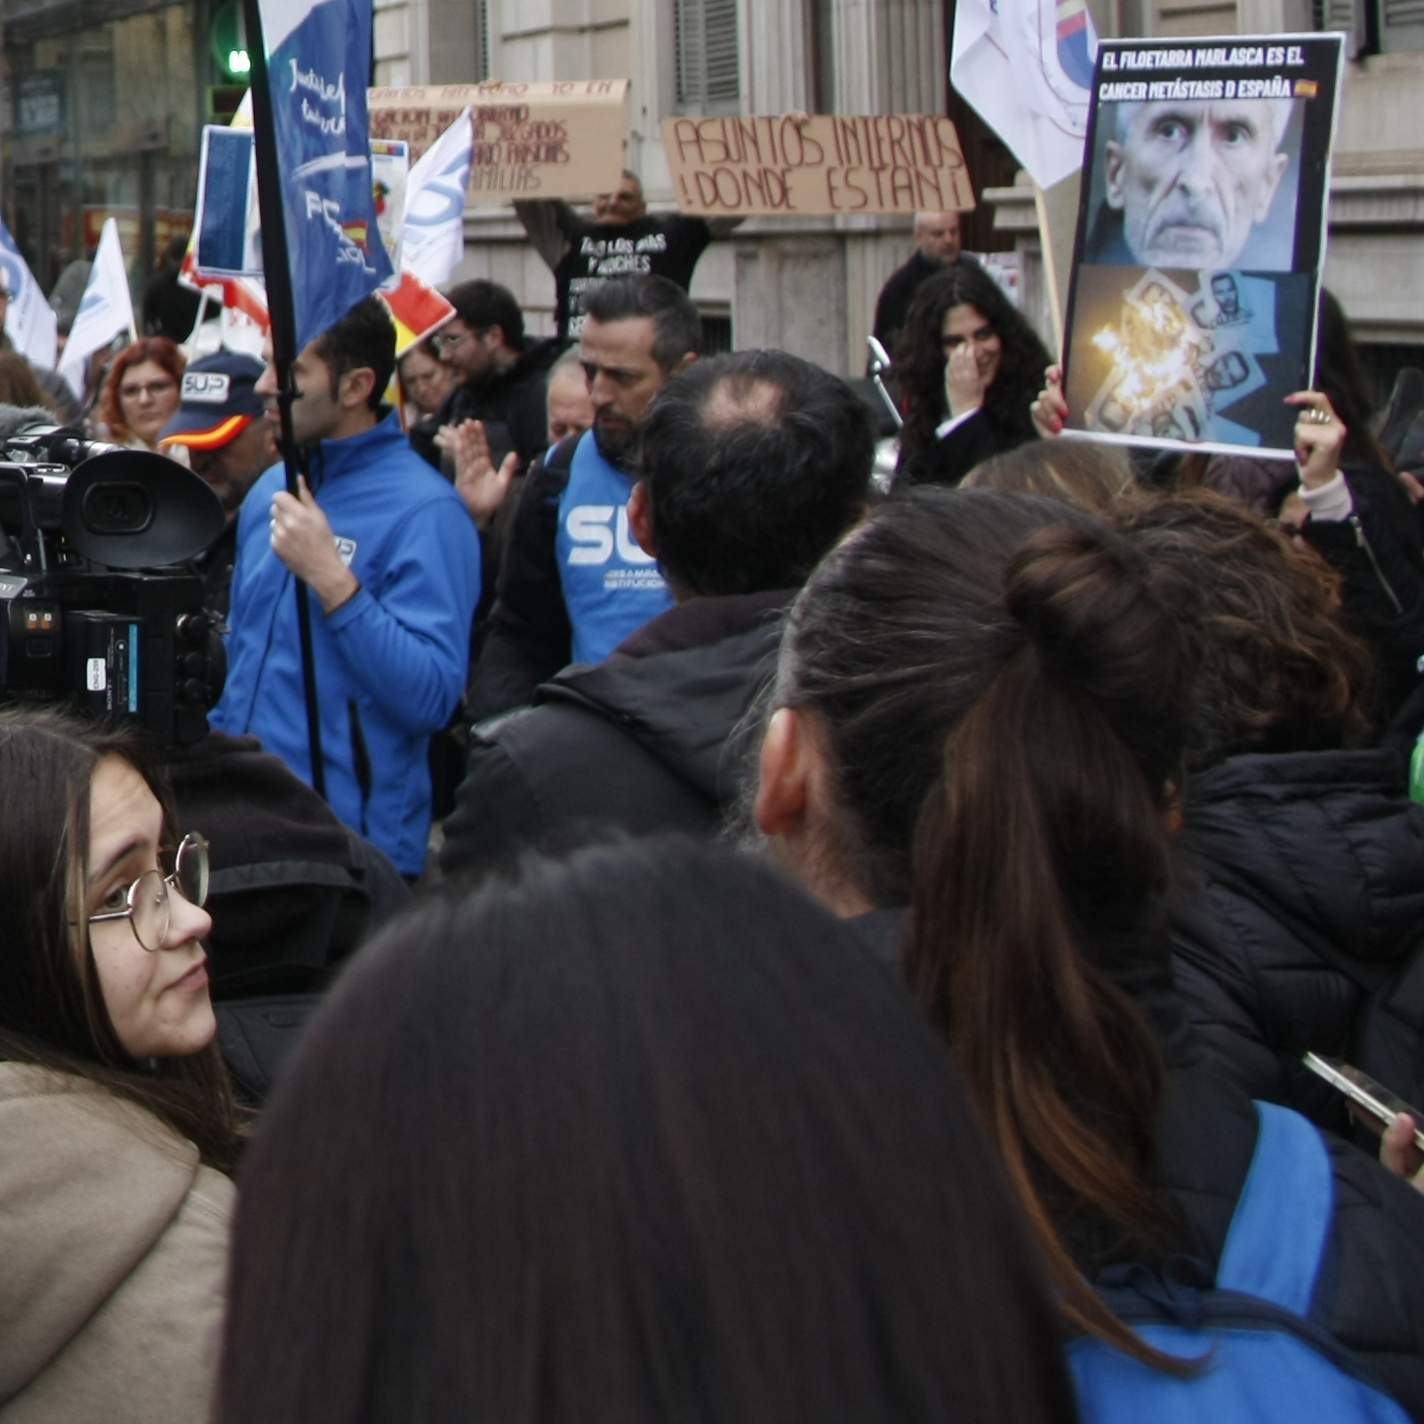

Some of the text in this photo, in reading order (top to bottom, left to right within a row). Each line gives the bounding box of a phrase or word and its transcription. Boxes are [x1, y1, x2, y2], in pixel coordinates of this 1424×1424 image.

[1103, 51, 1118, 70] EL
[1195, 48, 1265, 68] MARLASCA
[1267, 47, 1285, 66] ES
[1287, 46, 1304, 65] EL
[1099, 76, 1291, 102] CANCER METÁSTASIS D ESPAÑA
[674, 118, 825, 168] ASUNTOS
[184, 375, 225, 393] SUP
